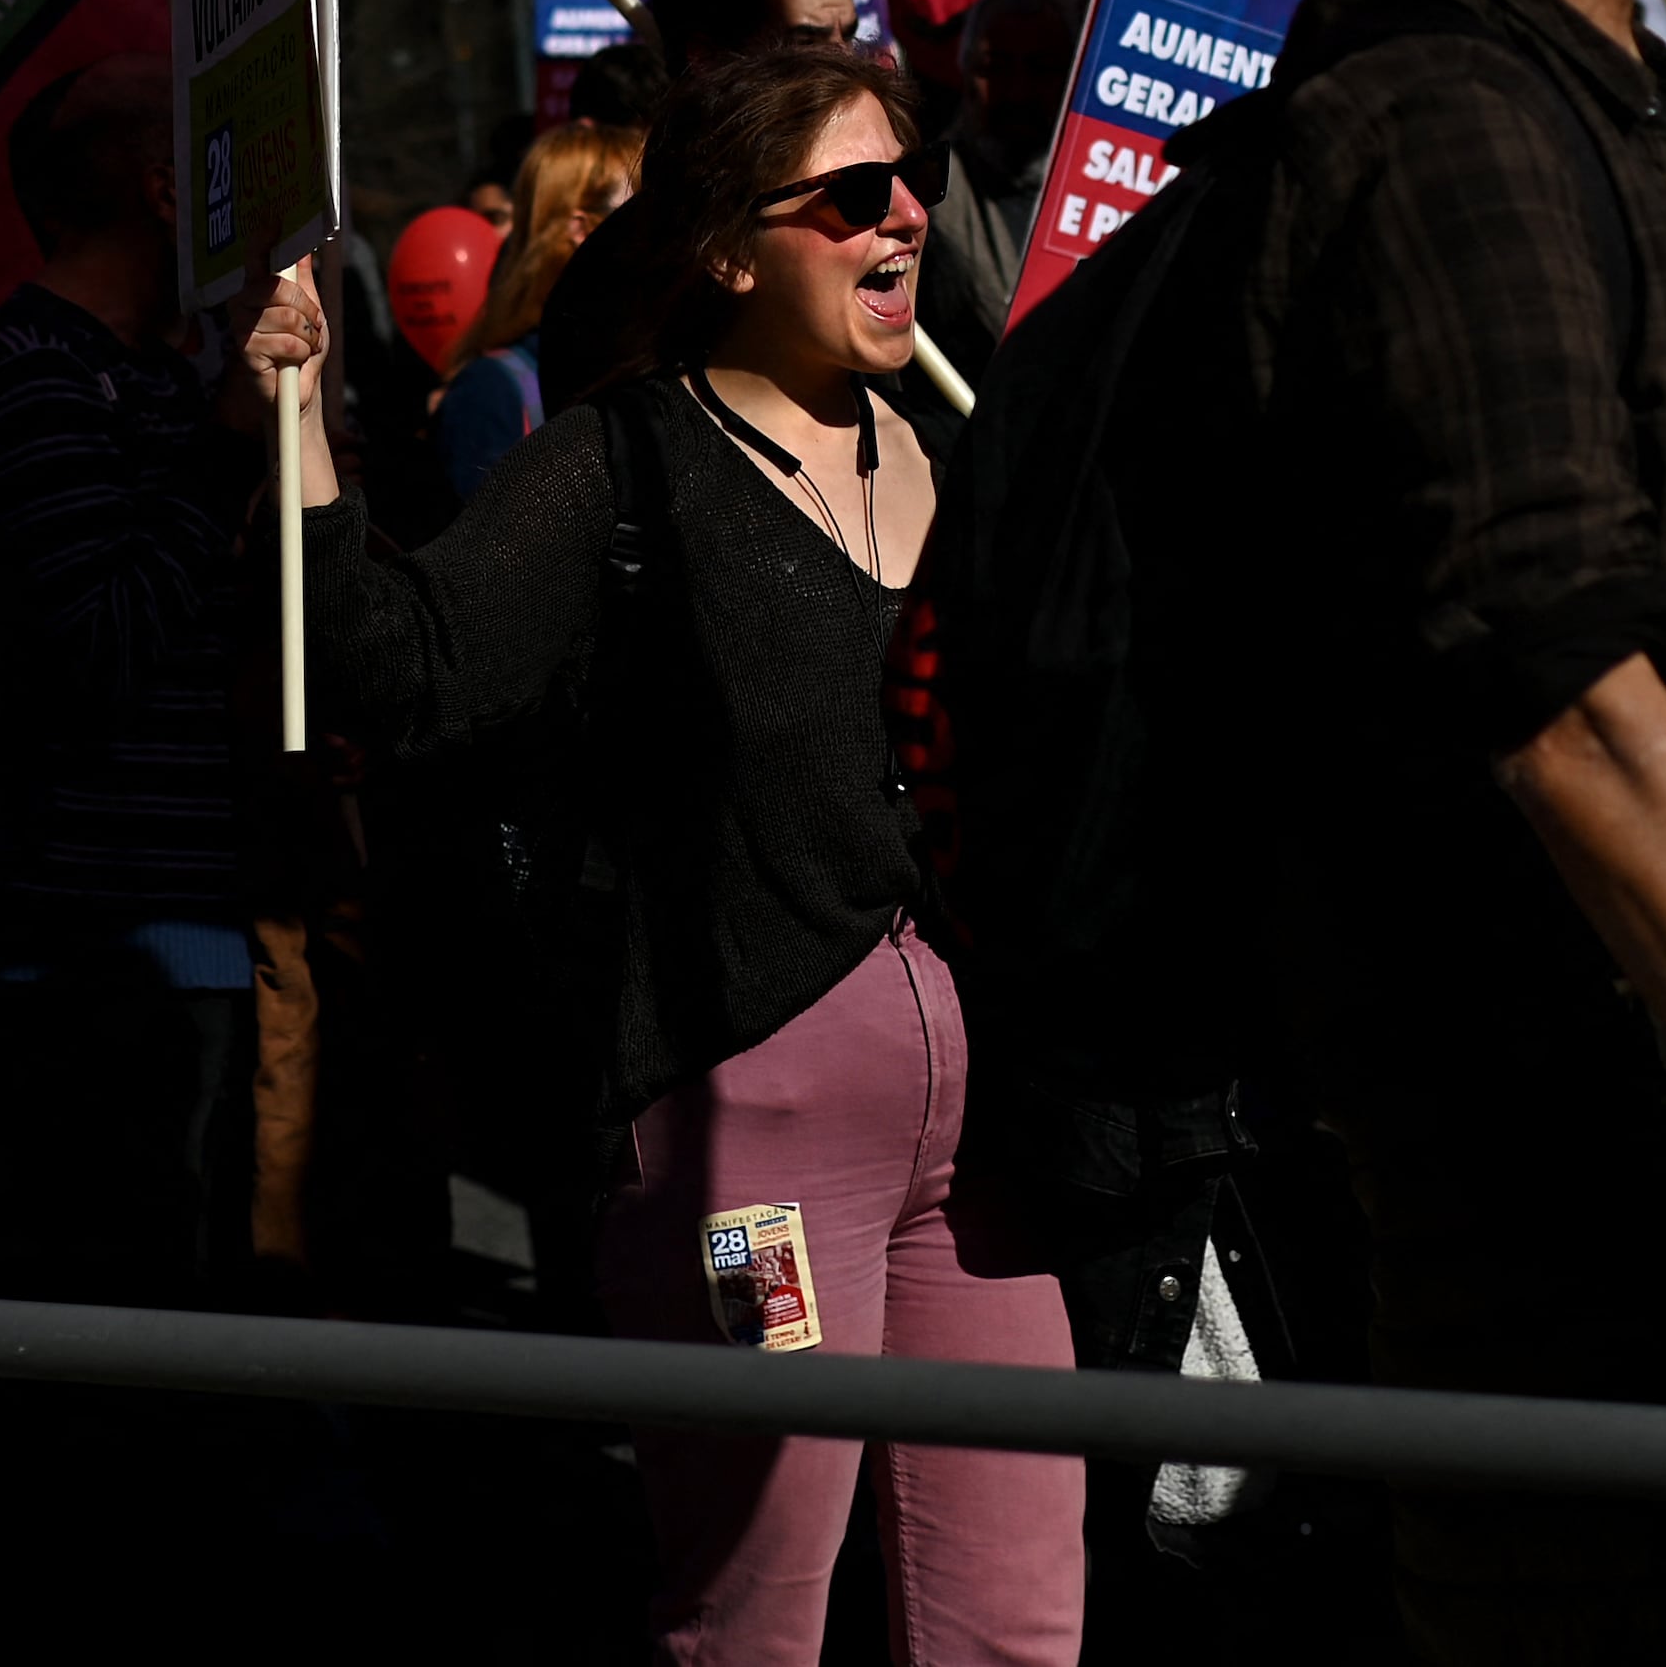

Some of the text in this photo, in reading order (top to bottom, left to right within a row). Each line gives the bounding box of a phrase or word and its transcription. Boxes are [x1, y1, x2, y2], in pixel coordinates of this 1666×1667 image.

[204, 32, 297, 126] MANIFESTAÇÃO
[1117, 10, 1278, 90] AUMENT
[207, 127, 232, 199] 28
[237, 118, 299, 205] JOVENS
[207, 197, 233, 252] mar
[710, 1229, 747, 1256] 28
[713, 1251, 749, 1270] mar
[757, 1225, 790, 1239] JOVENS
